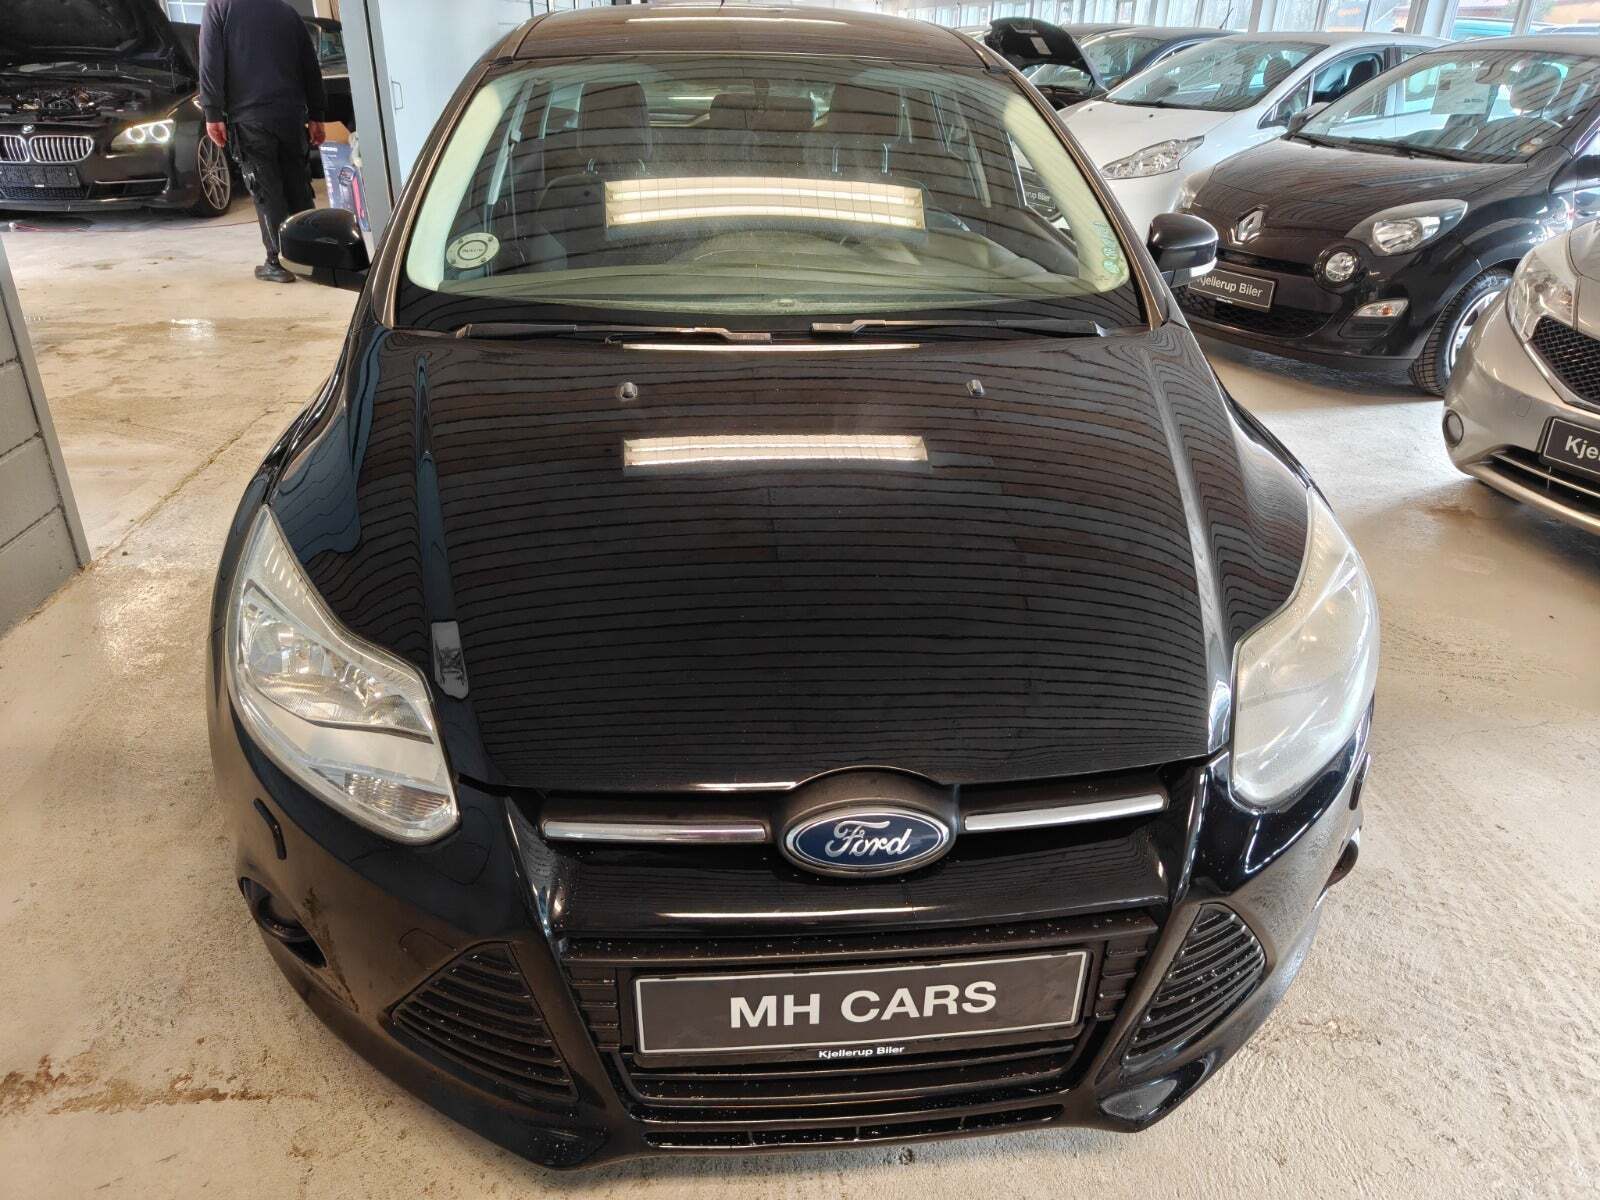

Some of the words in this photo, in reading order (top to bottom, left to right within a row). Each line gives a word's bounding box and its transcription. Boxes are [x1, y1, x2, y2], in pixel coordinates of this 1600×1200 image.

[1239, 282, 1263, 297] Biler
[1565, 435, 1600, 461] Kje
[825, 820, 912, 857] Ford
[730, 993, 820, 1028] MH
[841, 981, 997, 1023] CARS
[818, 1048, 873, 1059] Kjellerup
[876, 1046, 905, 1054] Biler
